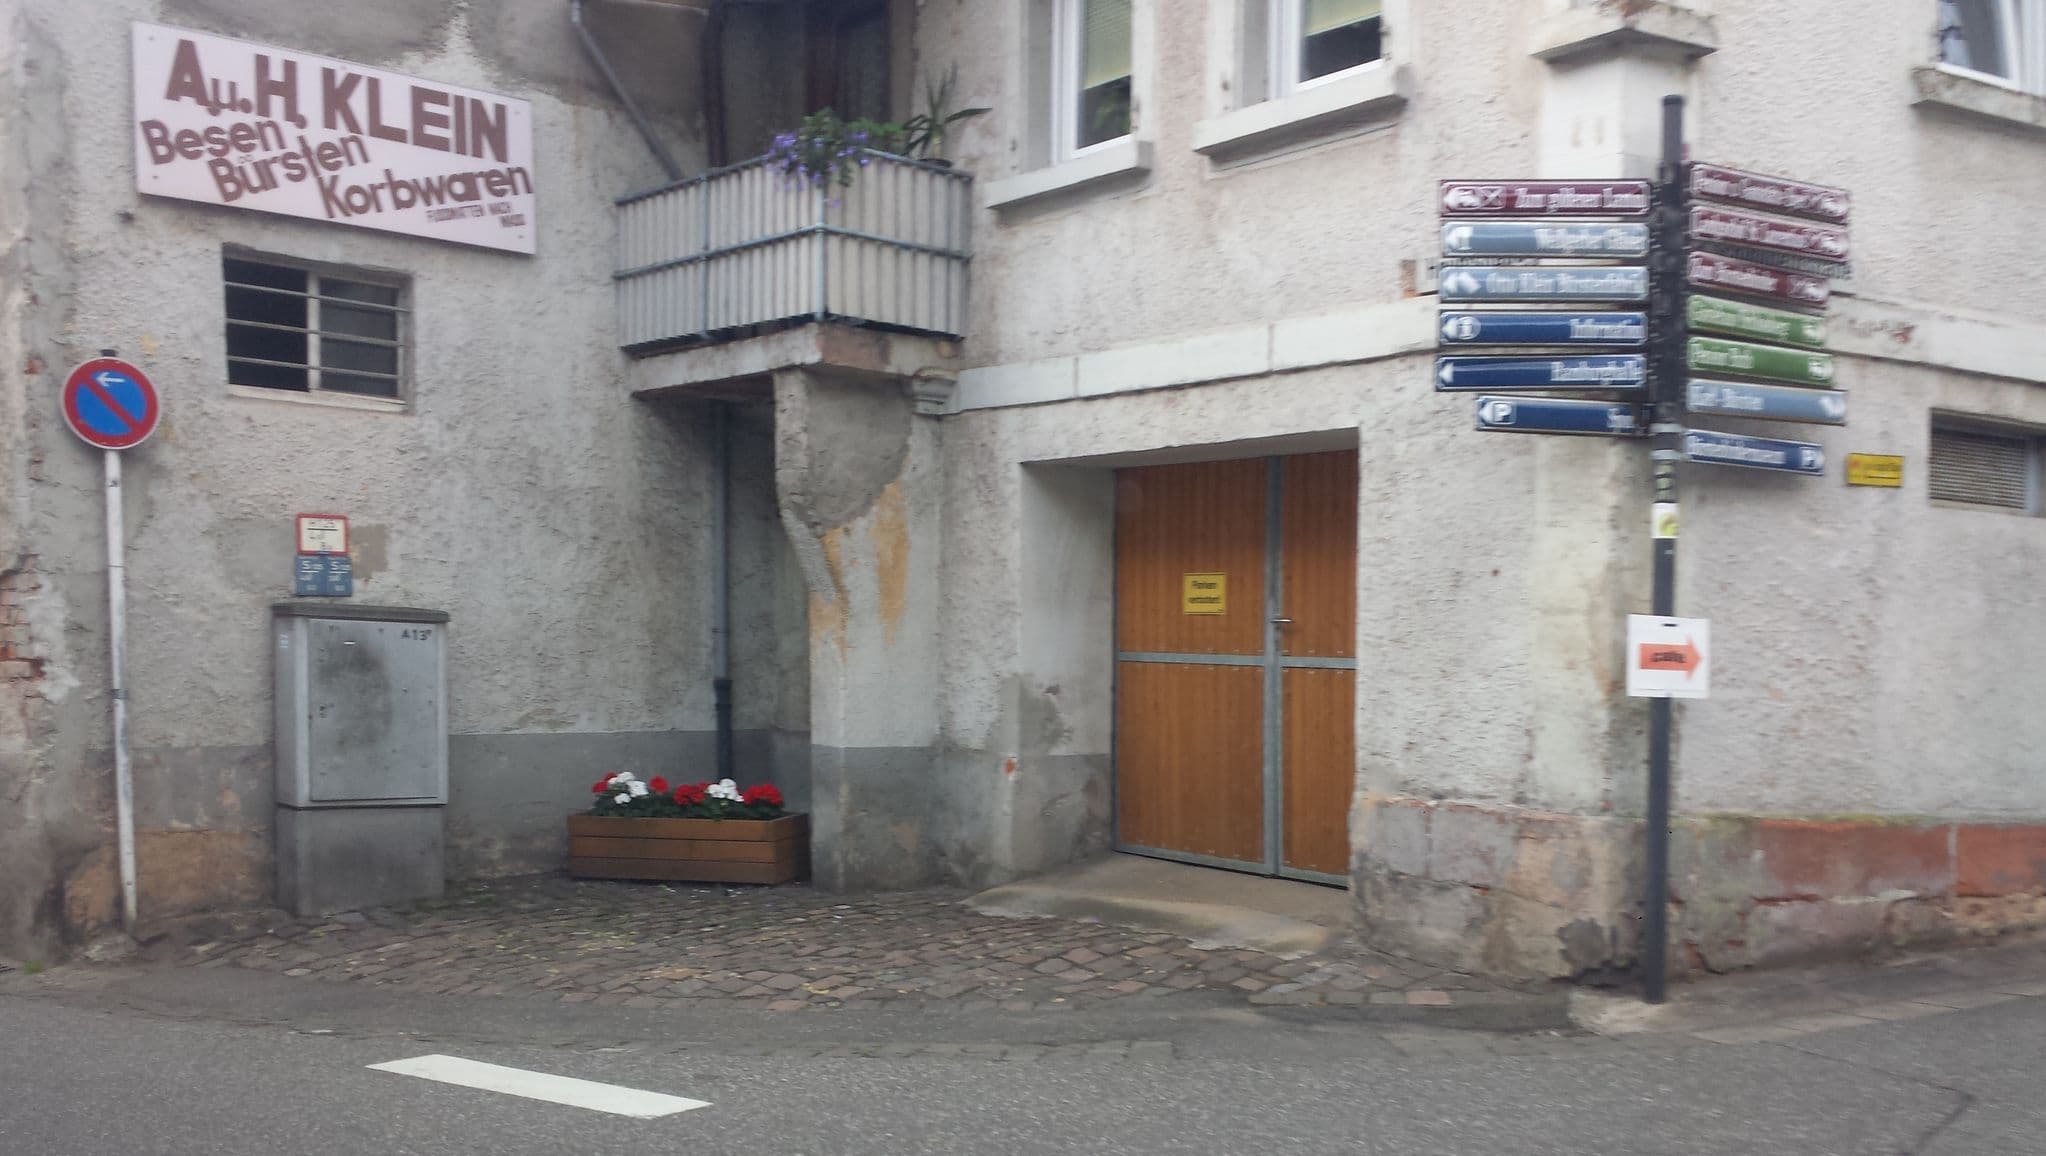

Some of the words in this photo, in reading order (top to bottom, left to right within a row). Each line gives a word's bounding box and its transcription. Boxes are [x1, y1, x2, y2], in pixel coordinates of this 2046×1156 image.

[140, 119, 286, 165] Besen
[321, 67, 509, 163] KLEIN
[207, 132, 369, 202] Bürsten
[318, 165, 534, 218] Korbwaren
